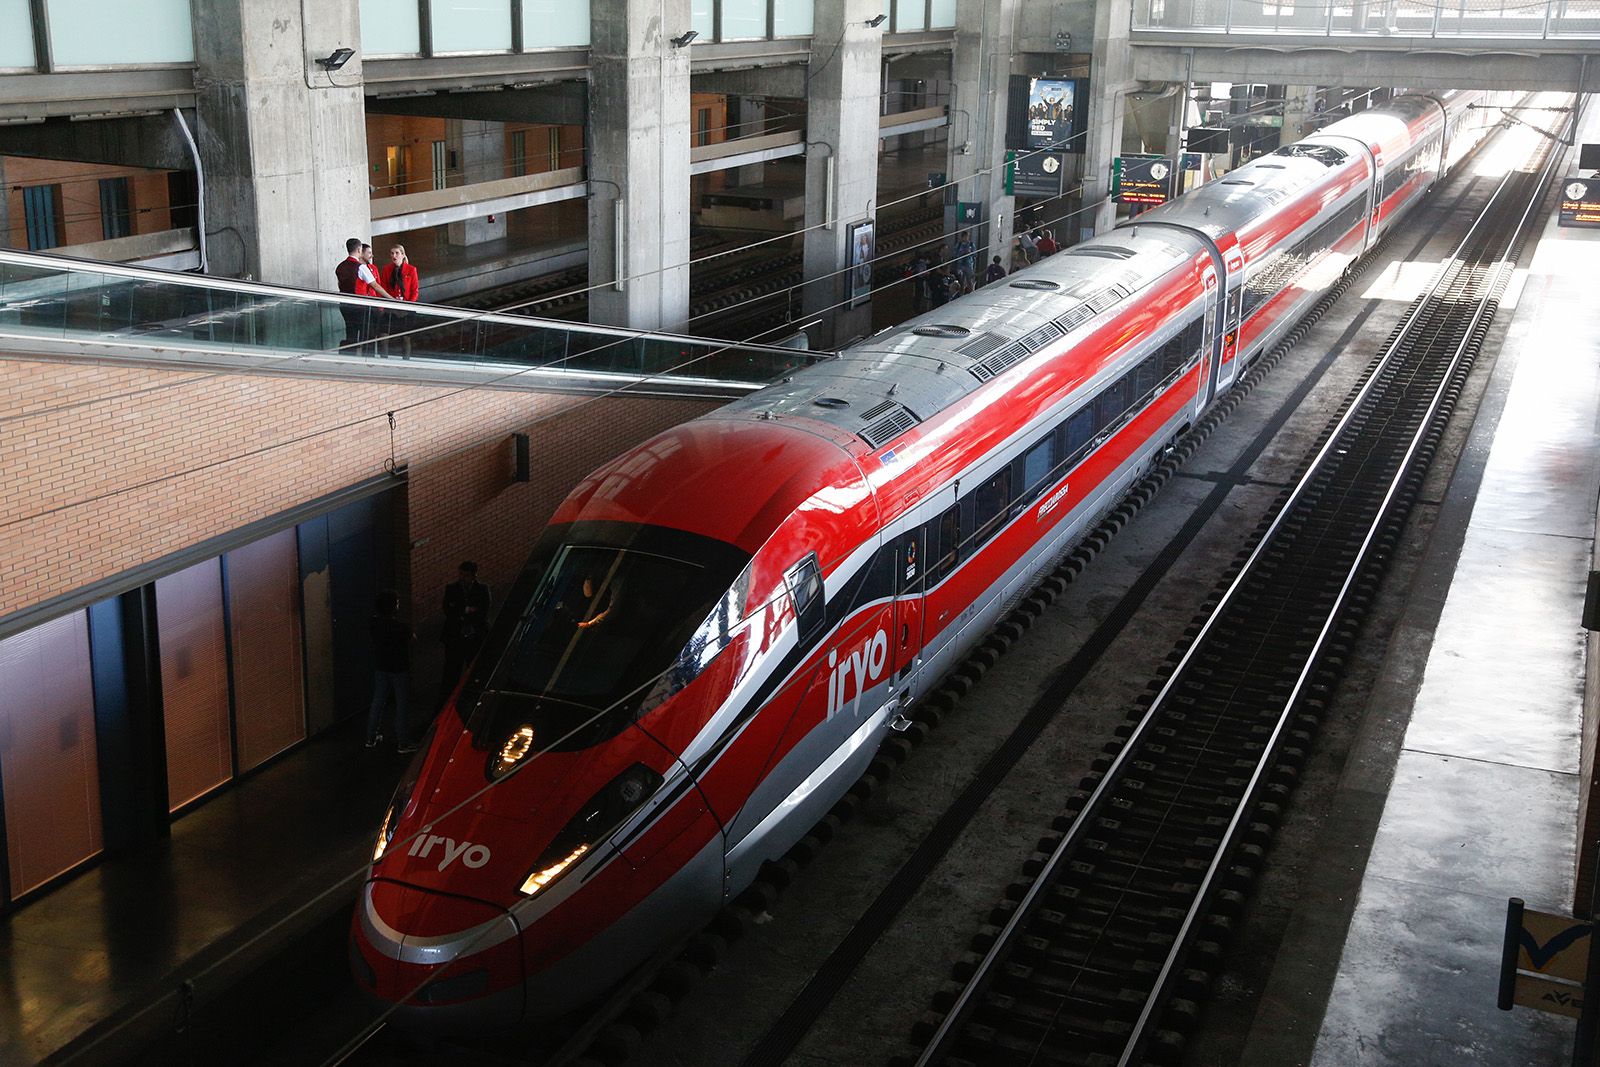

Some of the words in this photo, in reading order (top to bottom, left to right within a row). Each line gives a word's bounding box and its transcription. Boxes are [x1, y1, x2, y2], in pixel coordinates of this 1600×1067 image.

[1014, 161, 1020, 170] 1
[1187, 161, 1193, 169] 2
[826, 629, 887, 723] iryo
[407, 824, 491, 873] iryo
